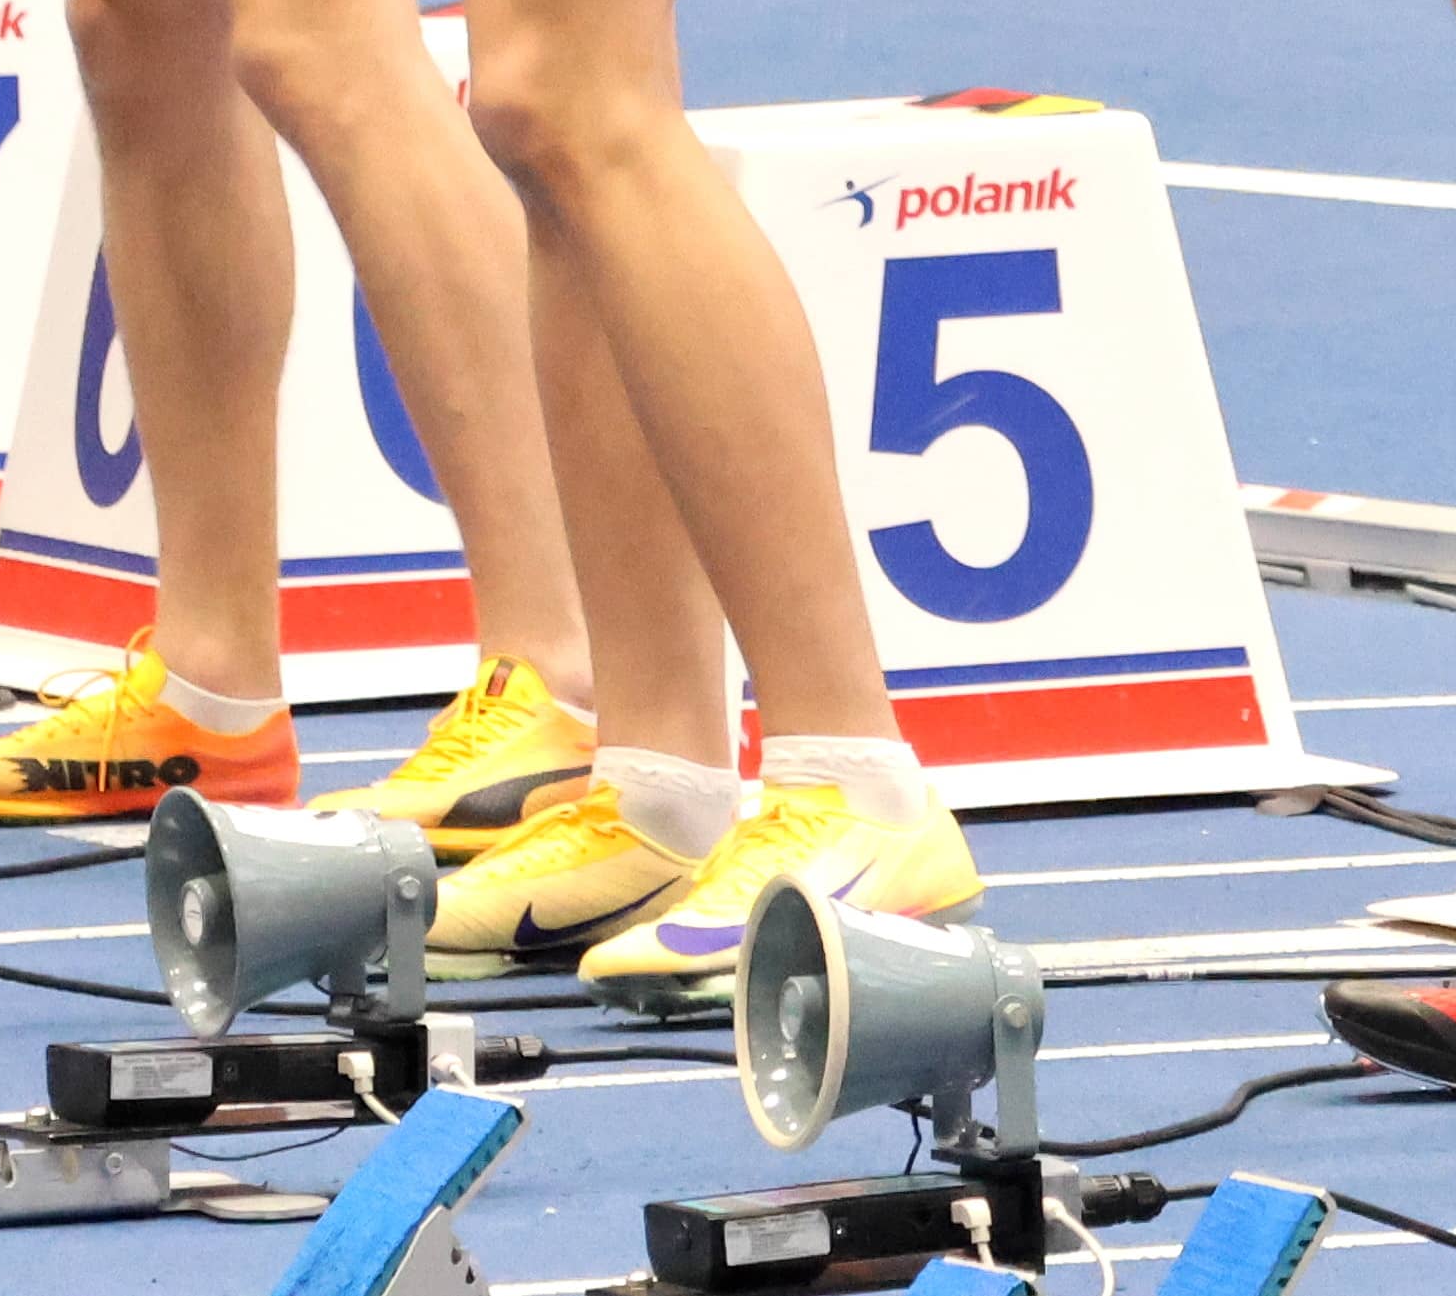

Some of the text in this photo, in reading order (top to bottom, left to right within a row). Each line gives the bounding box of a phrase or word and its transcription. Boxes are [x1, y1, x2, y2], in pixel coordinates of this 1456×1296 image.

[895, 167, 1079, 231] polanik
[869, 248, 1094, 624] 5
[1, 755, 202, 793] NITRO
